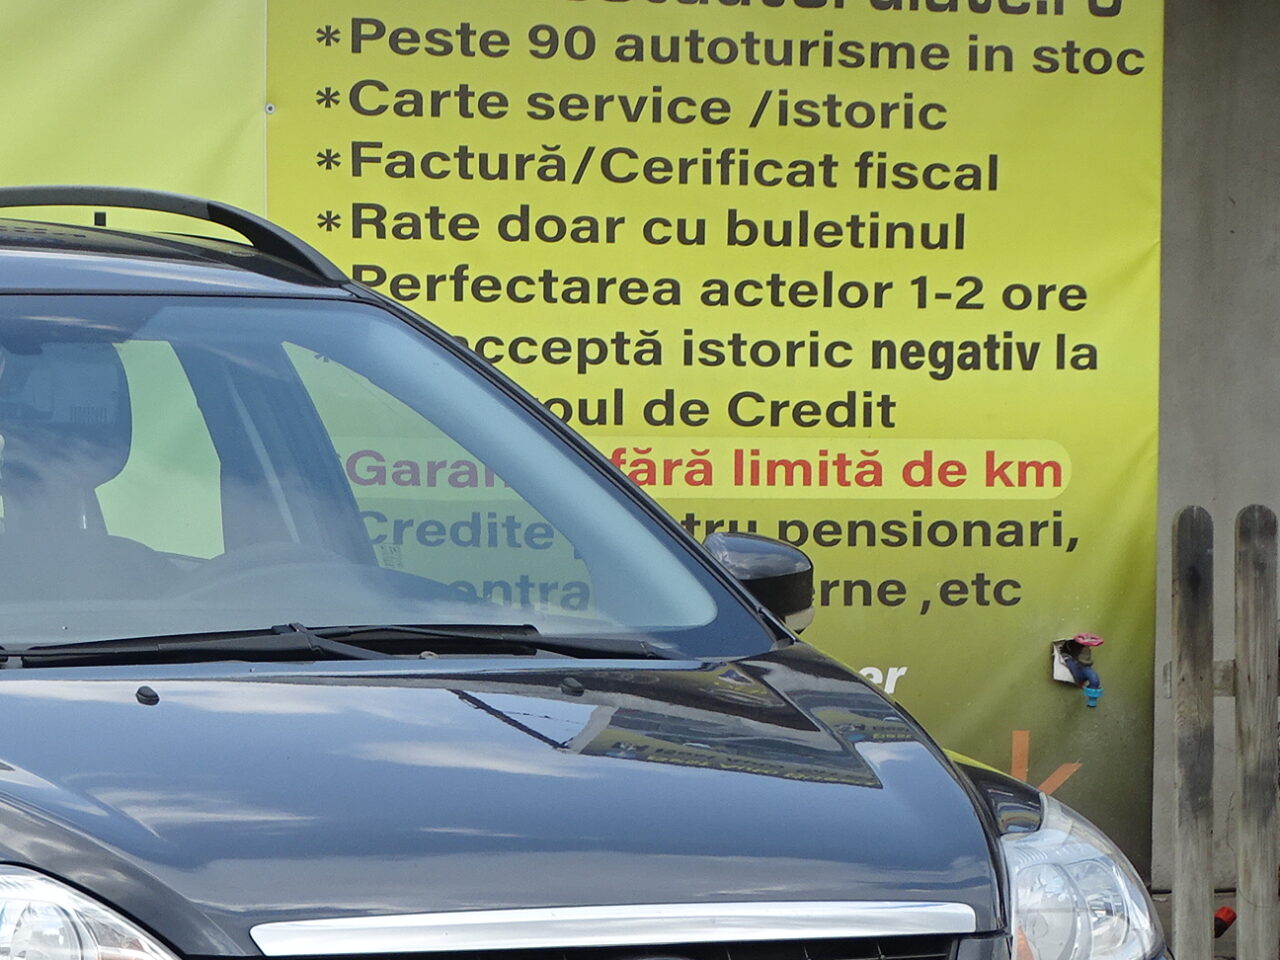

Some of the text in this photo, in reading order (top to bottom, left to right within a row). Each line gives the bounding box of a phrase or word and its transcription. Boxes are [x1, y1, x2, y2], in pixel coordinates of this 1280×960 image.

[528, 24, 595, 60] 90
[615, 30, 949, 70] autoturisme
[969, 34, 1013, 72] in
[1033, 41, 1144, 75] stoc
[527, 86, 731, 125] service
[749, 89, 947, 130] /istoric
[855, 151, 997, 191] fiscal
[498, 204, 625, 243] doar
[643, 218, 705, 245] cu
[727, 209, 964, 250] buletinul
[352, 264, 1087, 311] Perfectarea actelor 1-2 ore
[453, 329, 1097, 381] cceptă istoric negativ la
[536, 388, 896, 428] oul de Credit
[609, 447, 713, 486] fără
[734, 449, 882, 487] limită
[902, 450, 967, 487] de
[986, 451, 1061, 487] km
[360, 511, 554, 550] Credite
[778, 510, 1078, 552] pensionari,
